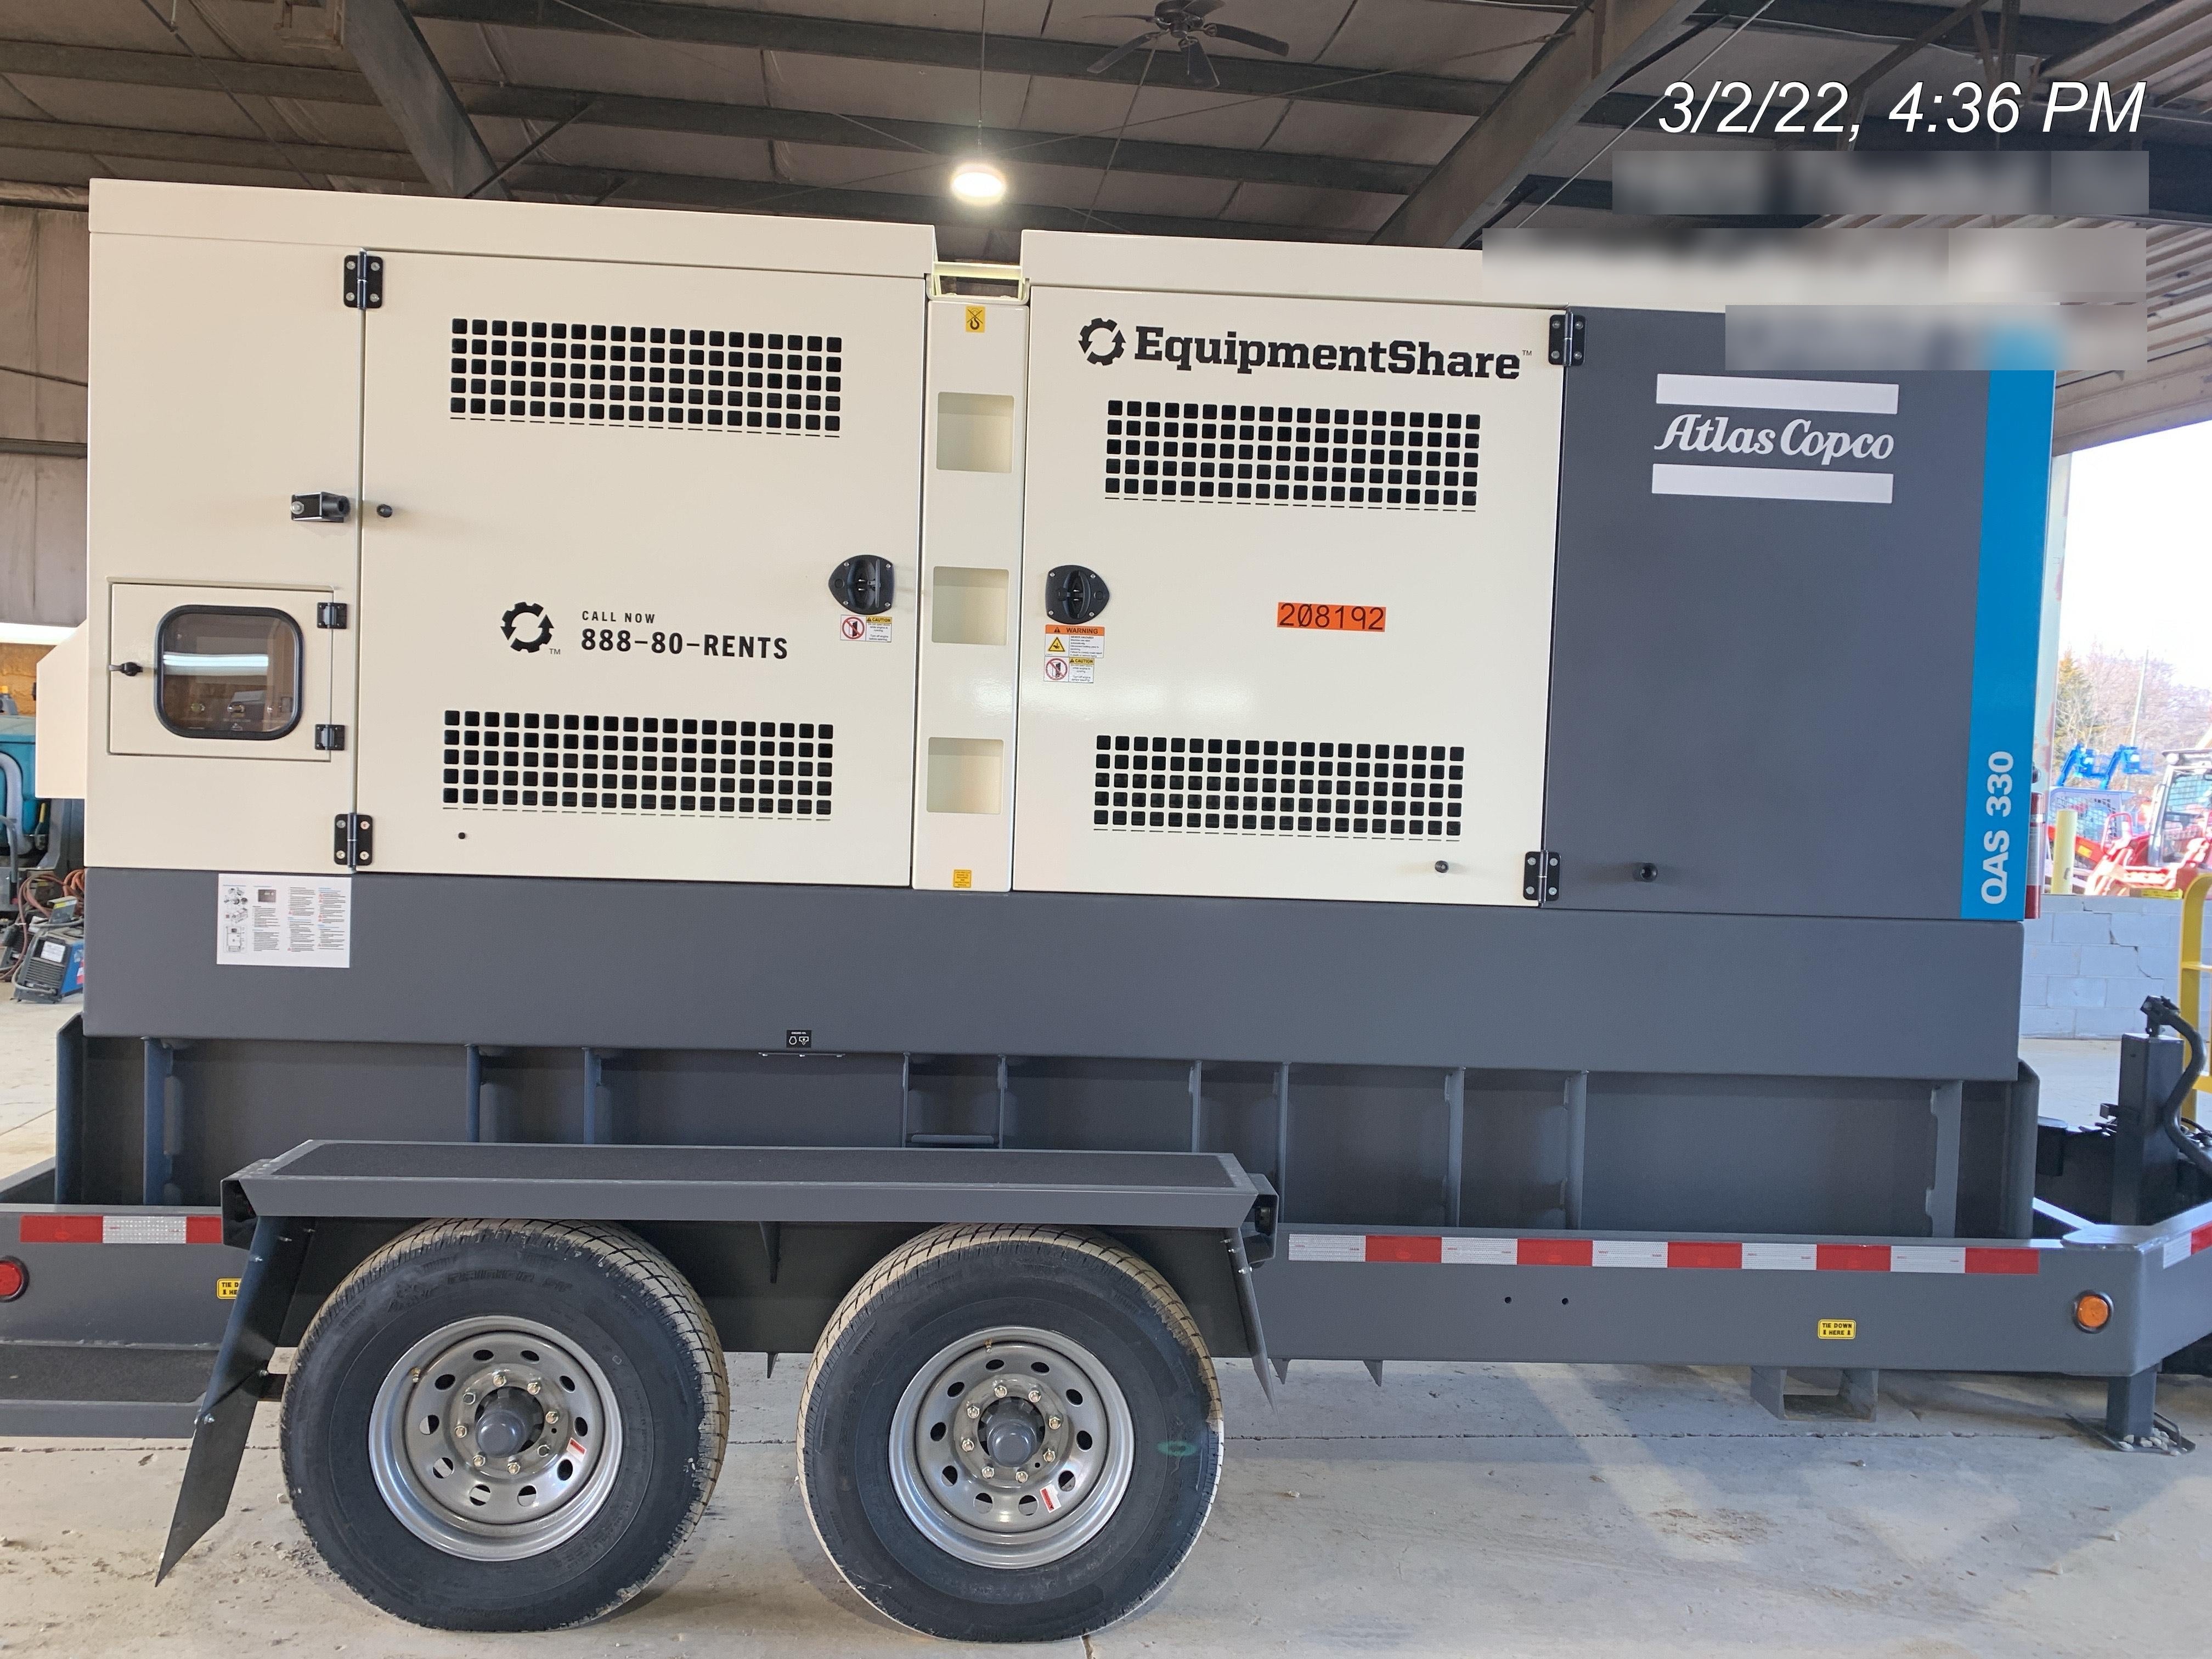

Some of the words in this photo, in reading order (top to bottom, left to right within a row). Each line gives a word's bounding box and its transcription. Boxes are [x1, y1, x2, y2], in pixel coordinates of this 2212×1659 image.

[1135, 325, 1520, 380] EquipmentShare
[1654, 413, 1776, 455] Atlas
[1780, 418, 1895, 465] Copco
[582, 610, 617, 622] CALL
[625, 612, 656, 624] NOW
[1279, 602, 1385, 630] 208192
[581, 628, 788, 659] 888-80-RENTS
[1985, 751, 2014, 817] 330
[1980, 830, 2010, 905] QAS
